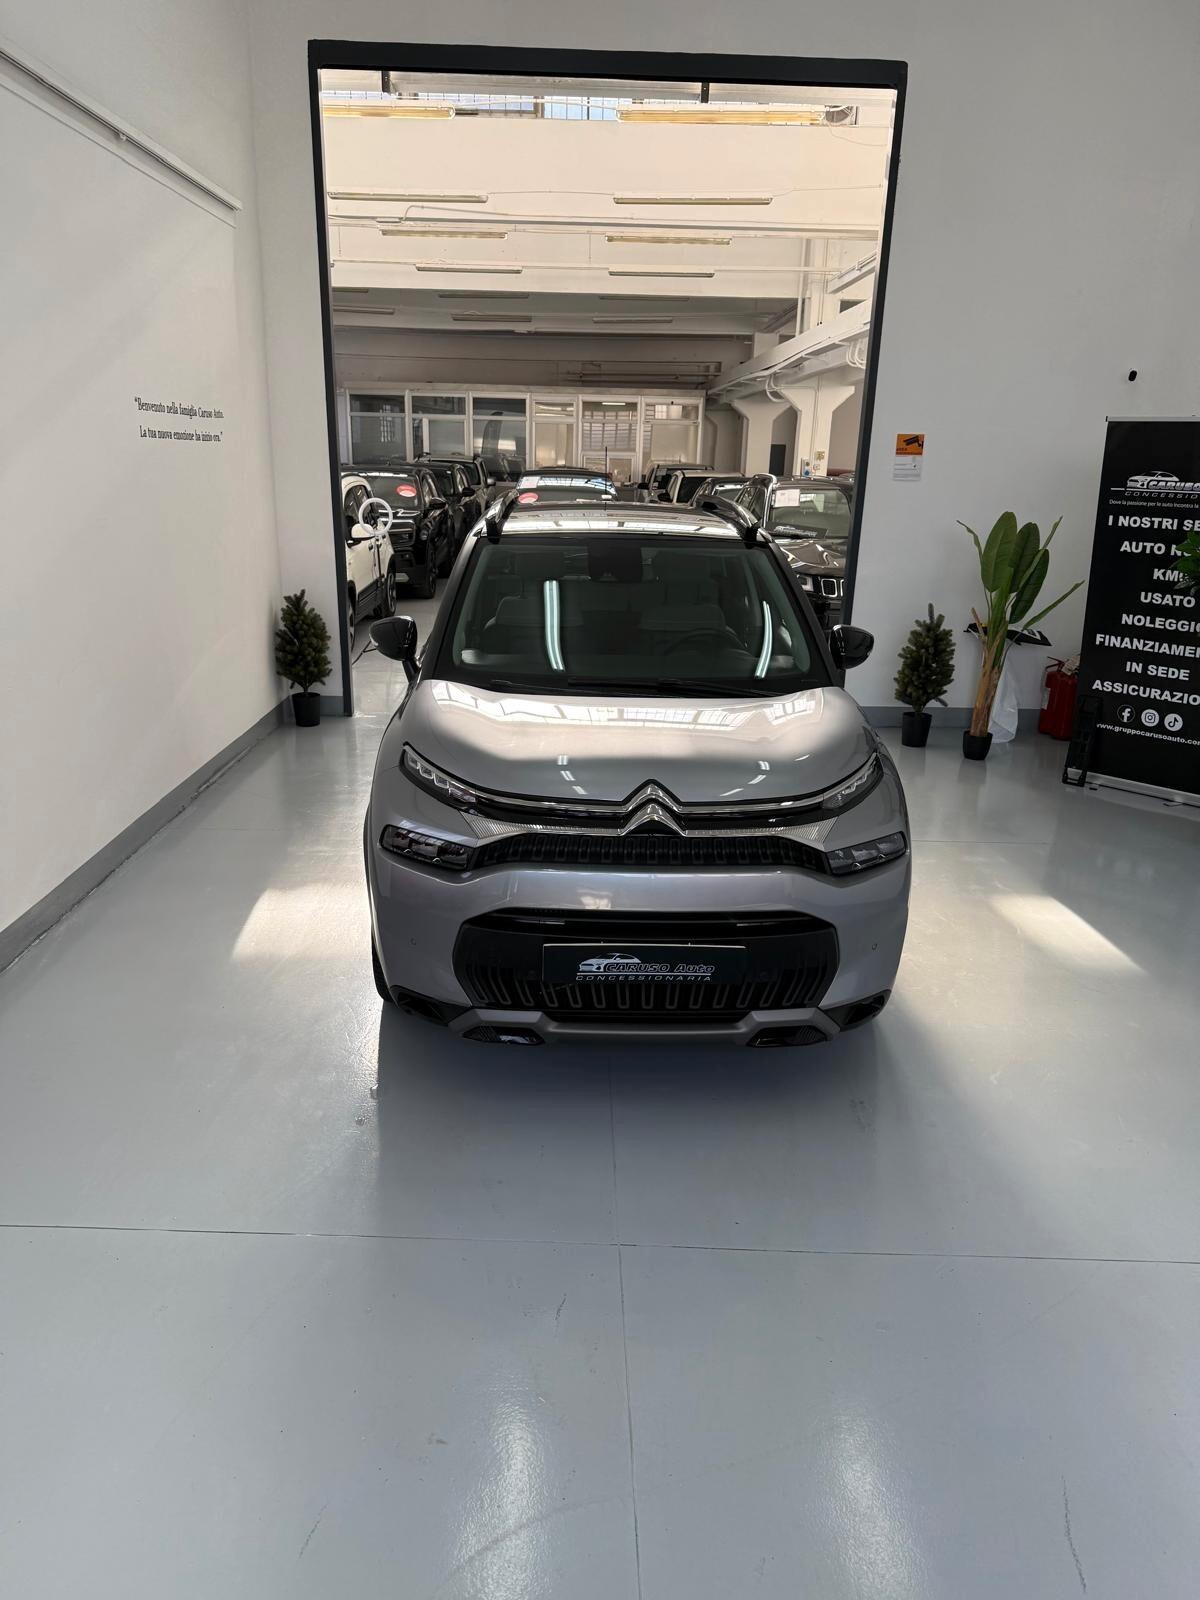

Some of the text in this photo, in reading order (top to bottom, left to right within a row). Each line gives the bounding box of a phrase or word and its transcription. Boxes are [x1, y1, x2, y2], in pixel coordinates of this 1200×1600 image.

[167, 401, 178, 414] nella
[180, 403, 197, 419] famiglia
[198, 407, 213, 418] Caruso
[140, 425, 147, 437] La
[148, 427, 157, 438] tua
[158, 430, 172, 439] nuova
[173, 429, 194, 440] emozione
[195, 429, 201, 441] ha
[201, 431, 212, 441] inizio
[1125, 491, 1198, 499] CONCESSIO
[1108, 515, 1200, 531] I NOSTRI SE
[1120, 541, 1166, 555] AUTO
[1140, 591, 1196, 608] USATO
[1125, 661, 1190, 681] IN SEDE
[1092, 679, 1200, 706] ASSICURAZIO
[605, 963, 715, 973] CARUSO Auto
